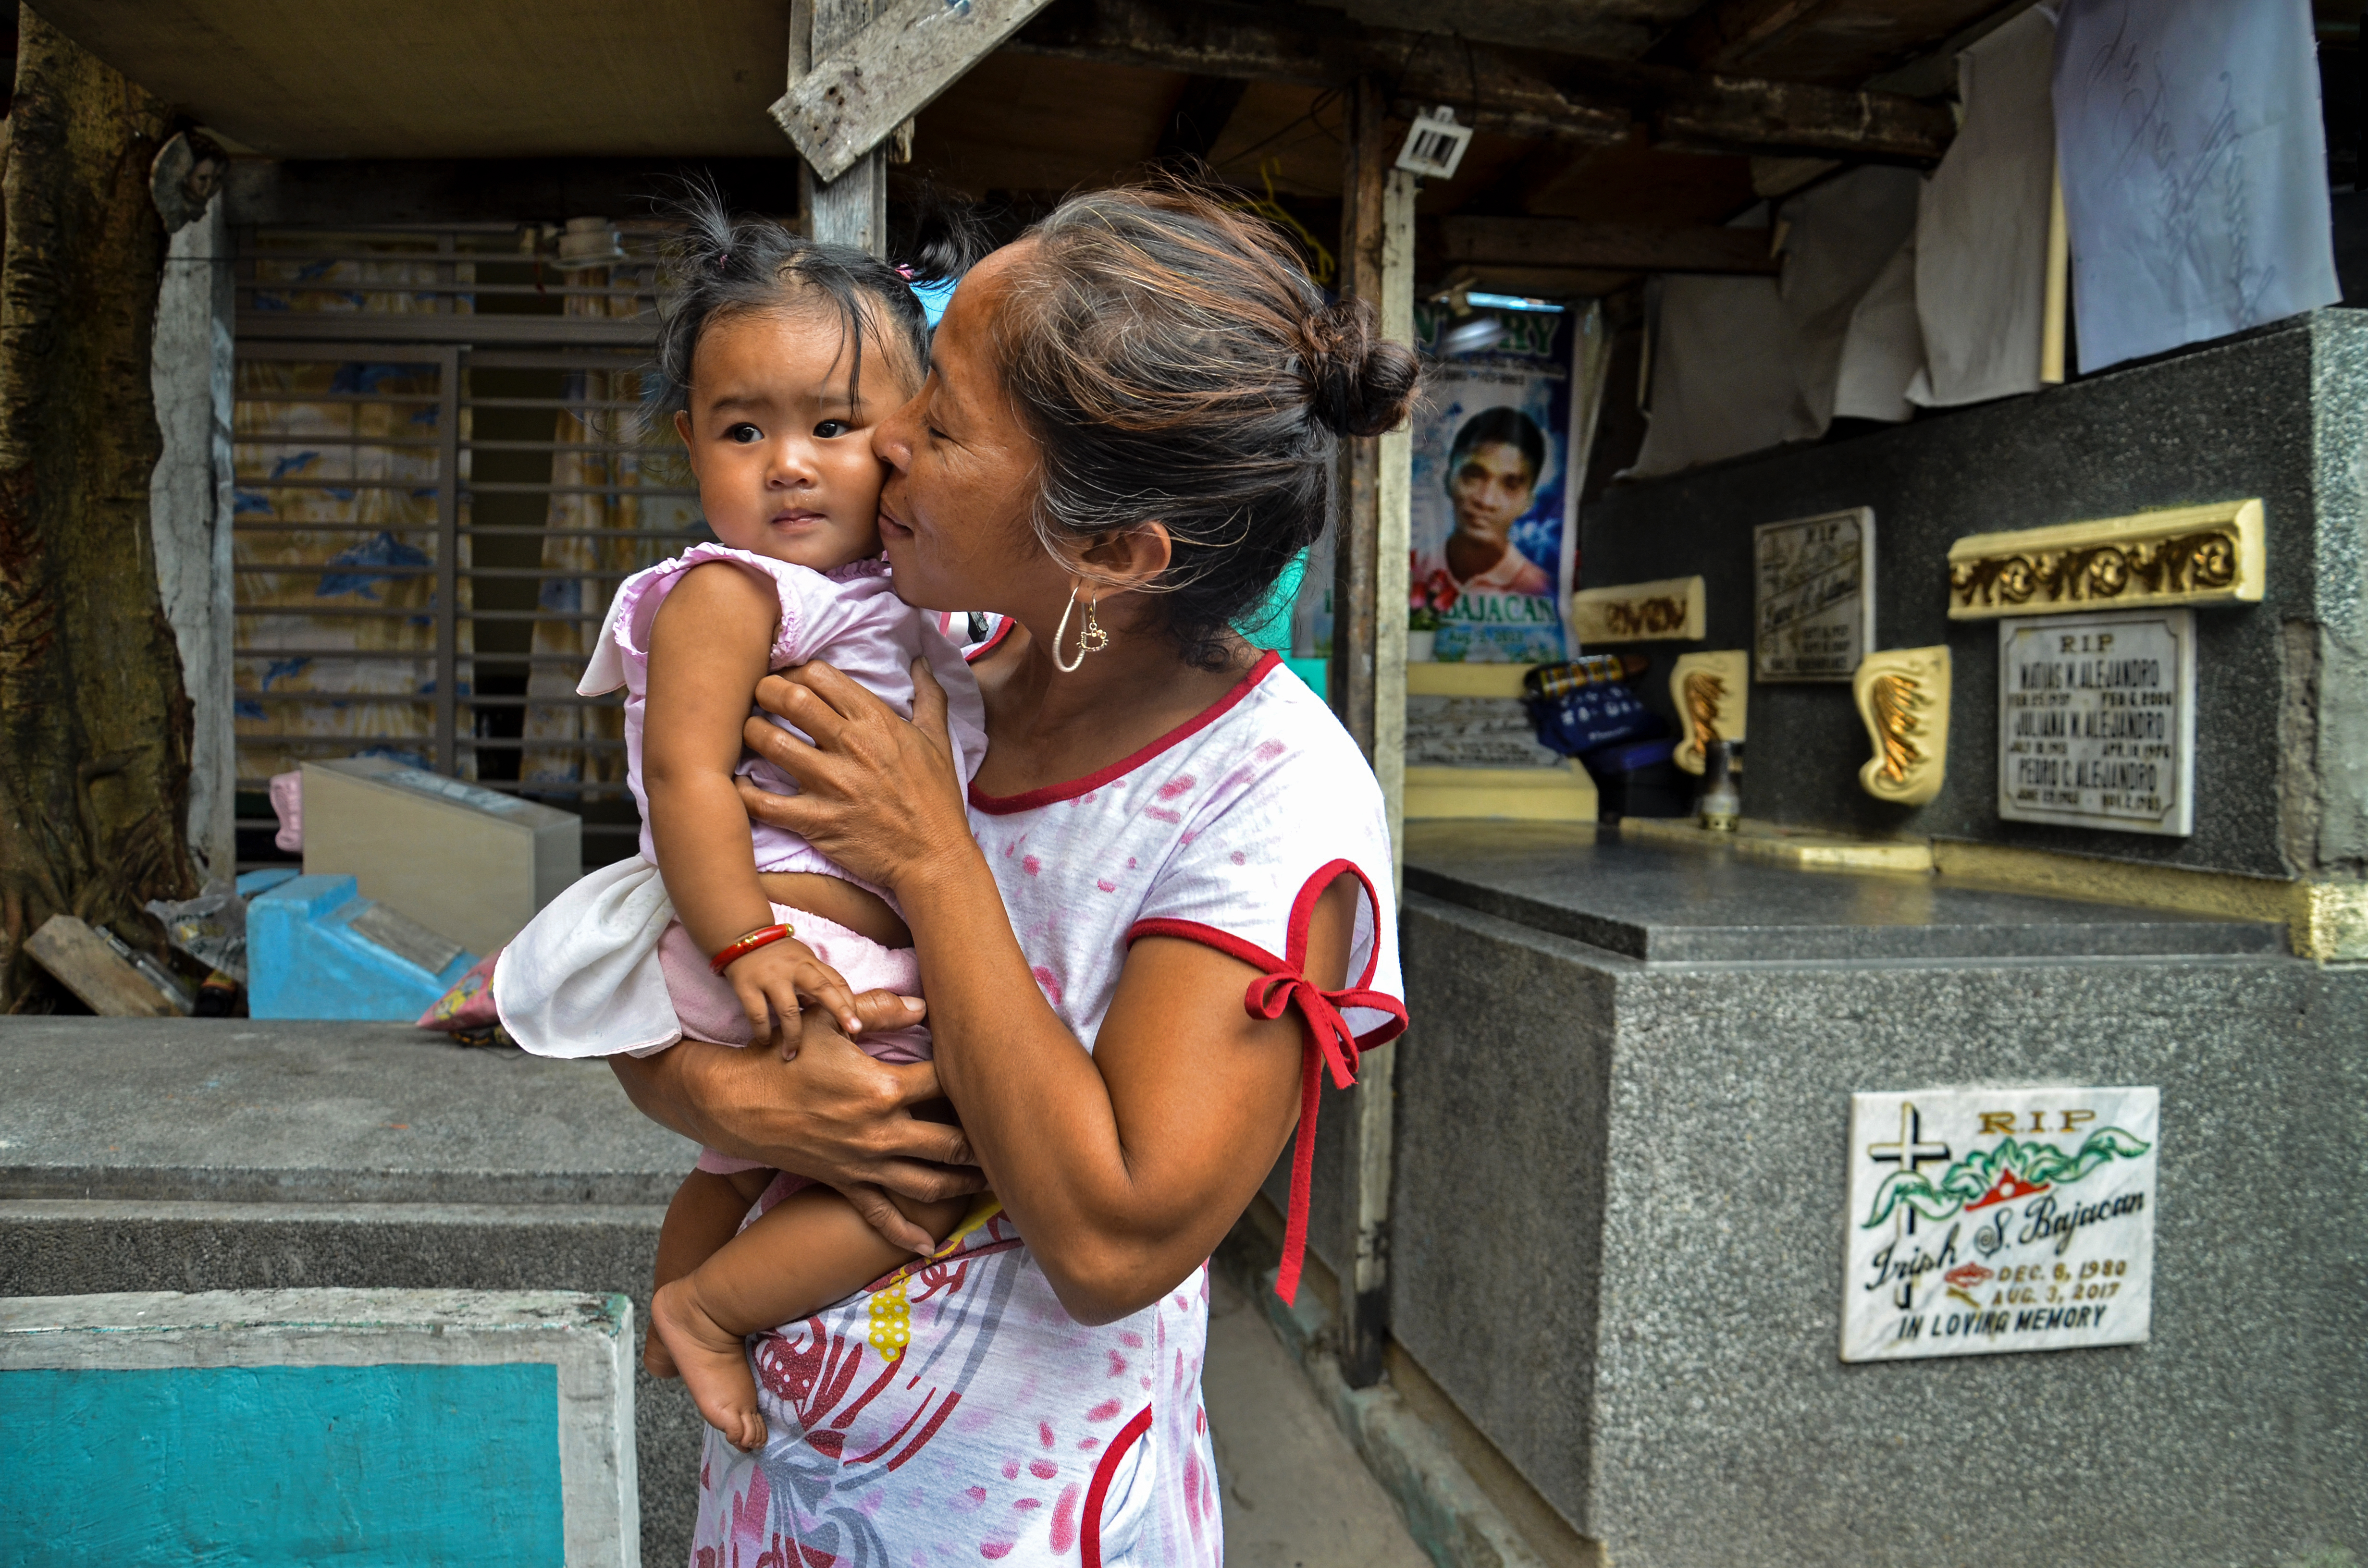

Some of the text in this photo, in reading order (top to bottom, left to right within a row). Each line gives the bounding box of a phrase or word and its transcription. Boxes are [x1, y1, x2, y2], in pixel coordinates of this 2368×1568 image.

[2080, 659, 2160, 688] ALEJANDRO
[2085, 710, 2166, 740] ALEJANDRO
[2075, 760, 2158, 793] ALEJANDRO
[1865, 1189, 2145, 1290] Irish S. Bajacan
[1998, 1264, 2045, 1283] DEC.
[2079, 1259, 2127, 1280] 1980
[2072, 1281, 2120, 1300] 2017
[1899, 1304, 2107, 1339] IN LOVING MEMORY
